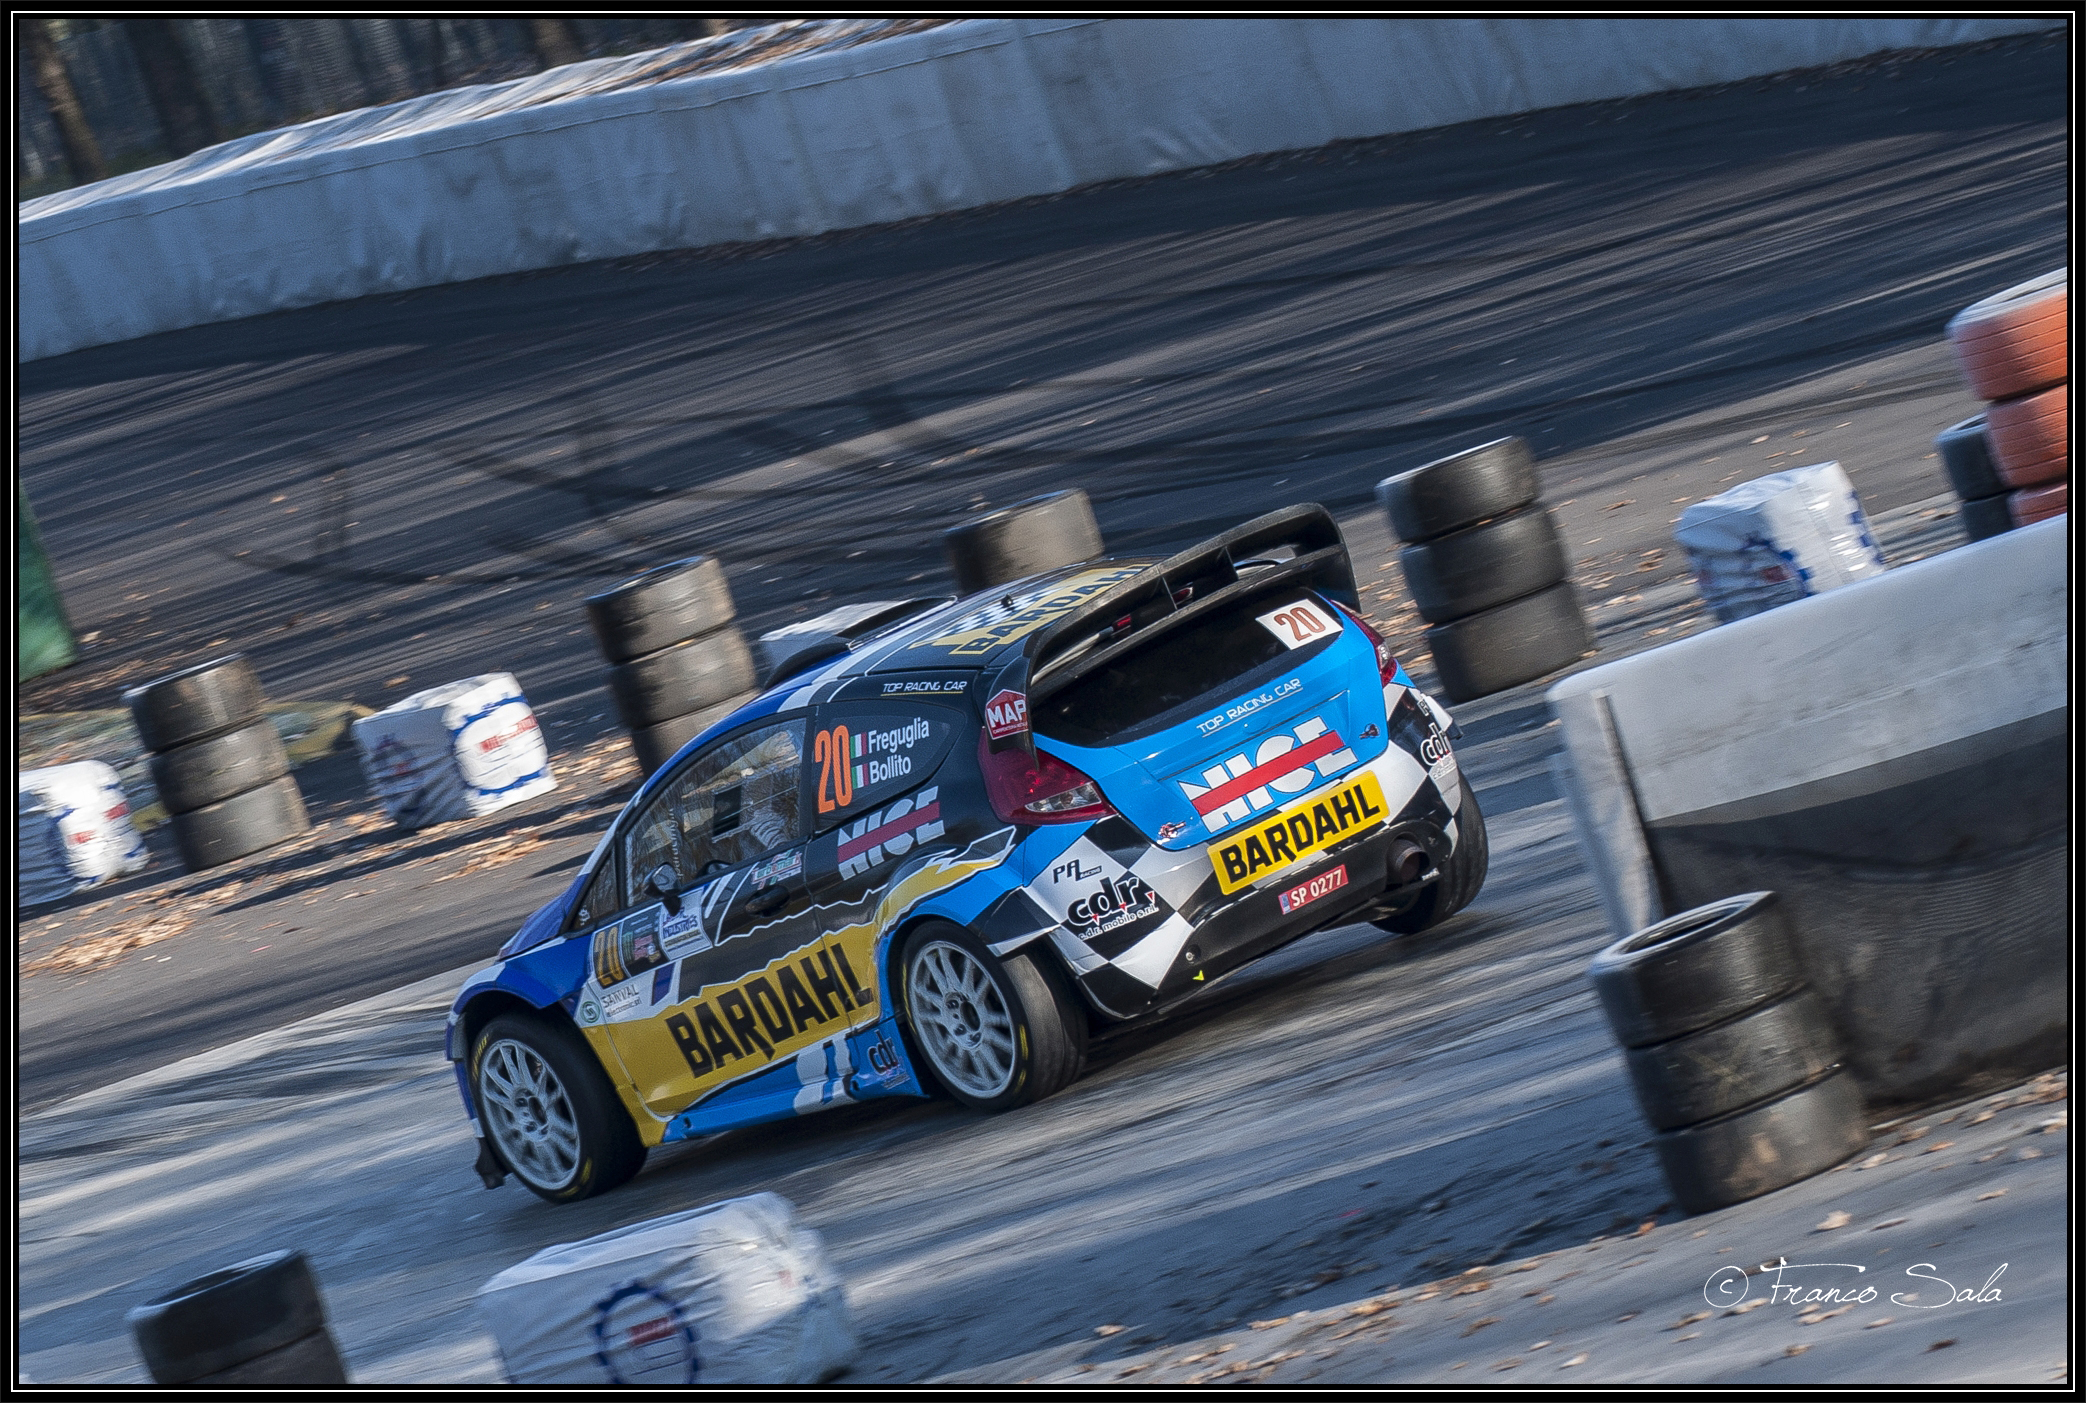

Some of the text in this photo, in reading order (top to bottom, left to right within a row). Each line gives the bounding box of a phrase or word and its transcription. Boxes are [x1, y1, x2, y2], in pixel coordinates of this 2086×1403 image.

[957, 564, 1151, 653] BARDAH
[1274, 607, 1326, 642] 20
[882, 681, 967, 693] TOP RACING CAR
[1196, 678, 1302, 733] TOP RACING CAR
[868, 717, 930, 754] Freguglia
[987, 699, 1027, 728] MAP
[815, 725, 852, 814] 20
[870, 755, 912, 785] Bollito
[1177, 716, 1359, 834] NICE
[838, 786, 945, 881] NICE
[1220, 784, 1381, 884] BARDAHL
[1068, 877, 1139, 926] cdr
[1291, 869, 1342, 907] SP 0277
[1103, 911, 1137, 932] mobile
[594, 926, 624, 987] 20
[601, 984, 640, 1008] SANVAL
[664, 943, 875, 1079] BARDAHL
[868, 1029, 899, 1076] cdr
